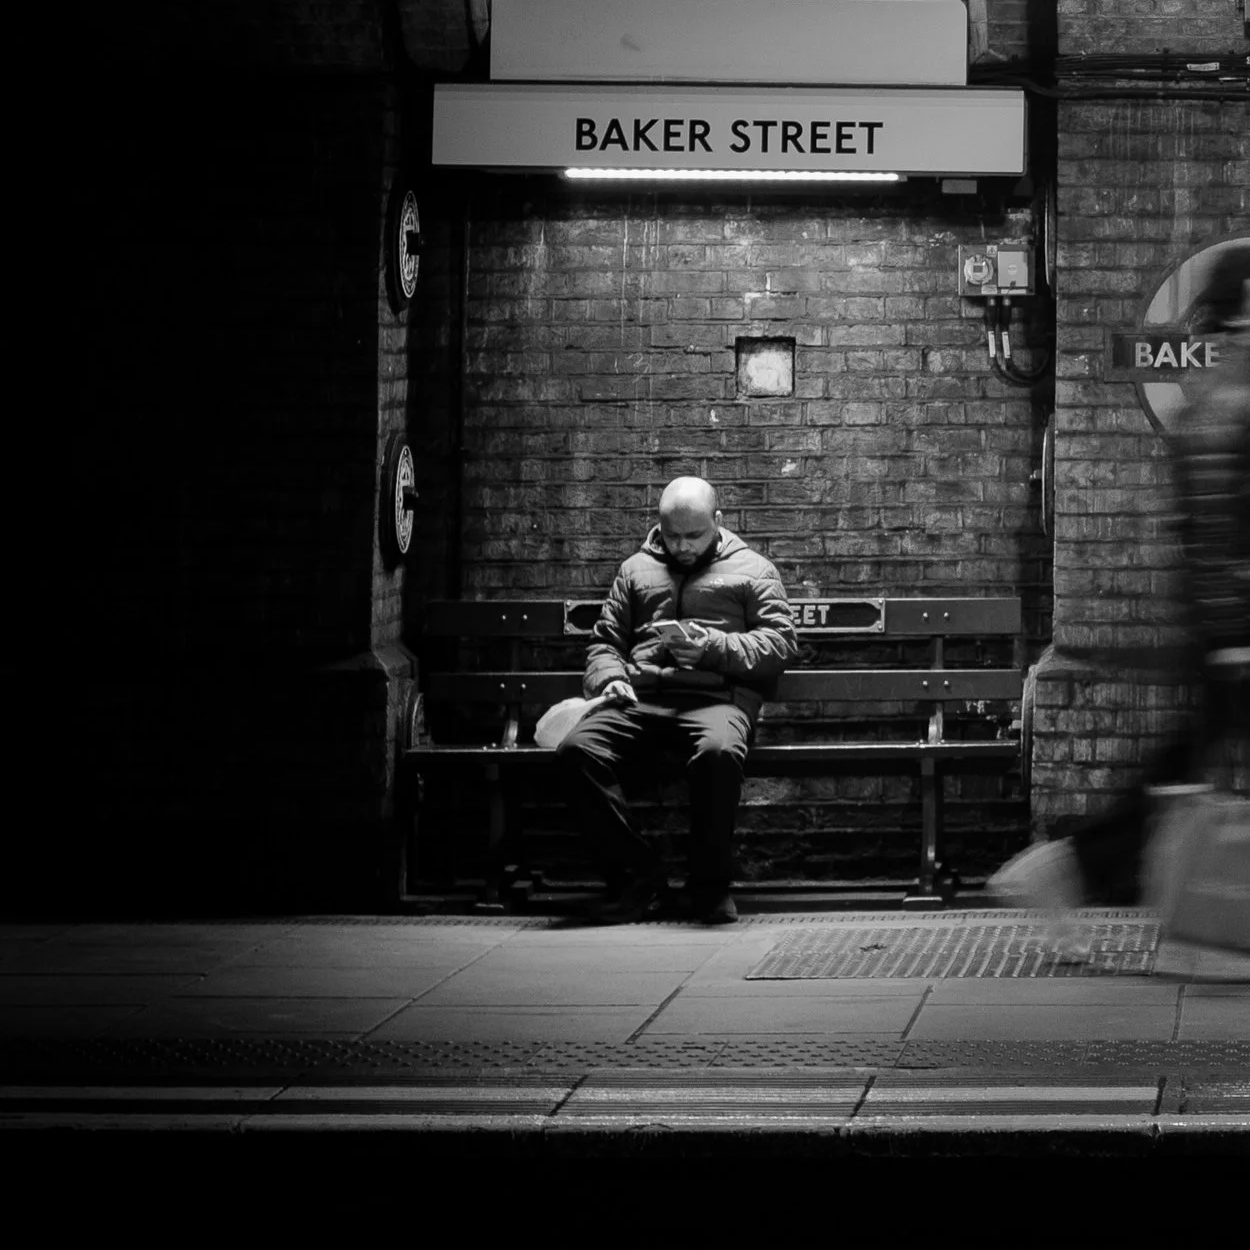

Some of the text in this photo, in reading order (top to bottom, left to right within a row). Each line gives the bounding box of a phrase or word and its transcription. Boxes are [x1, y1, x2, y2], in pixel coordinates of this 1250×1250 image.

[575, 117, 884, 155] BAKER STREET
[1134, 341, 1221, 368] BAKE
